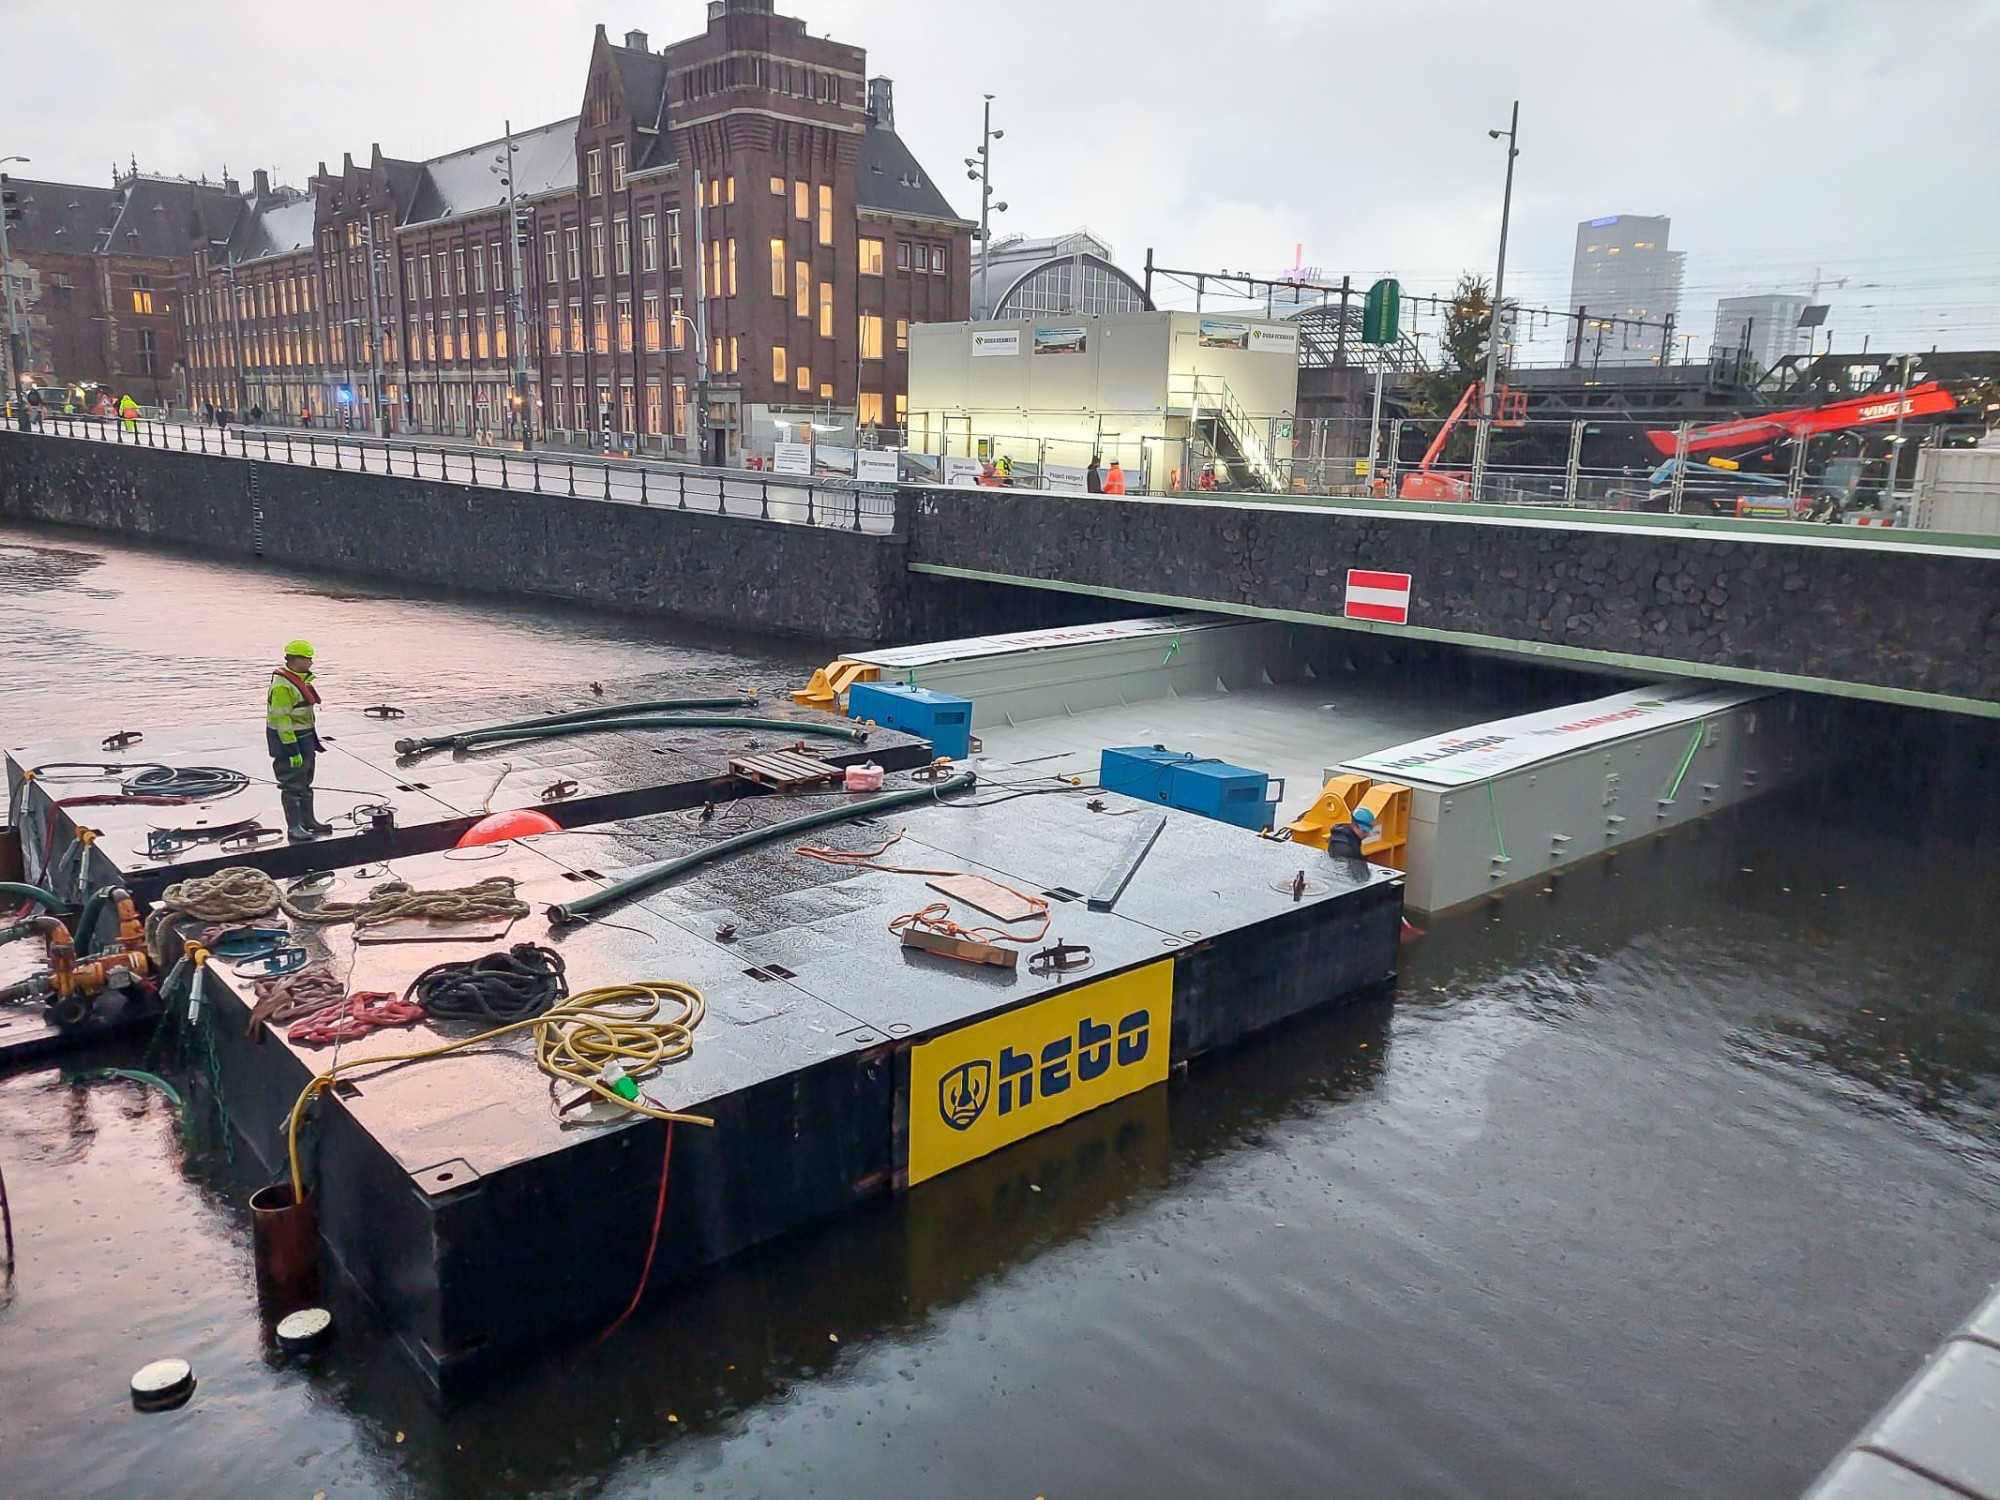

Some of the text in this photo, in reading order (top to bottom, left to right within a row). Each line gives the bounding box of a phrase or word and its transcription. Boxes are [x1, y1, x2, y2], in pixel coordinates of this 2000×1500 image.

[1382, 736, 1515, 769] HOLLANDIA
[1461, 751, 1533, 770] INFRA
[998, 1009, 1149, 1116] hebo
